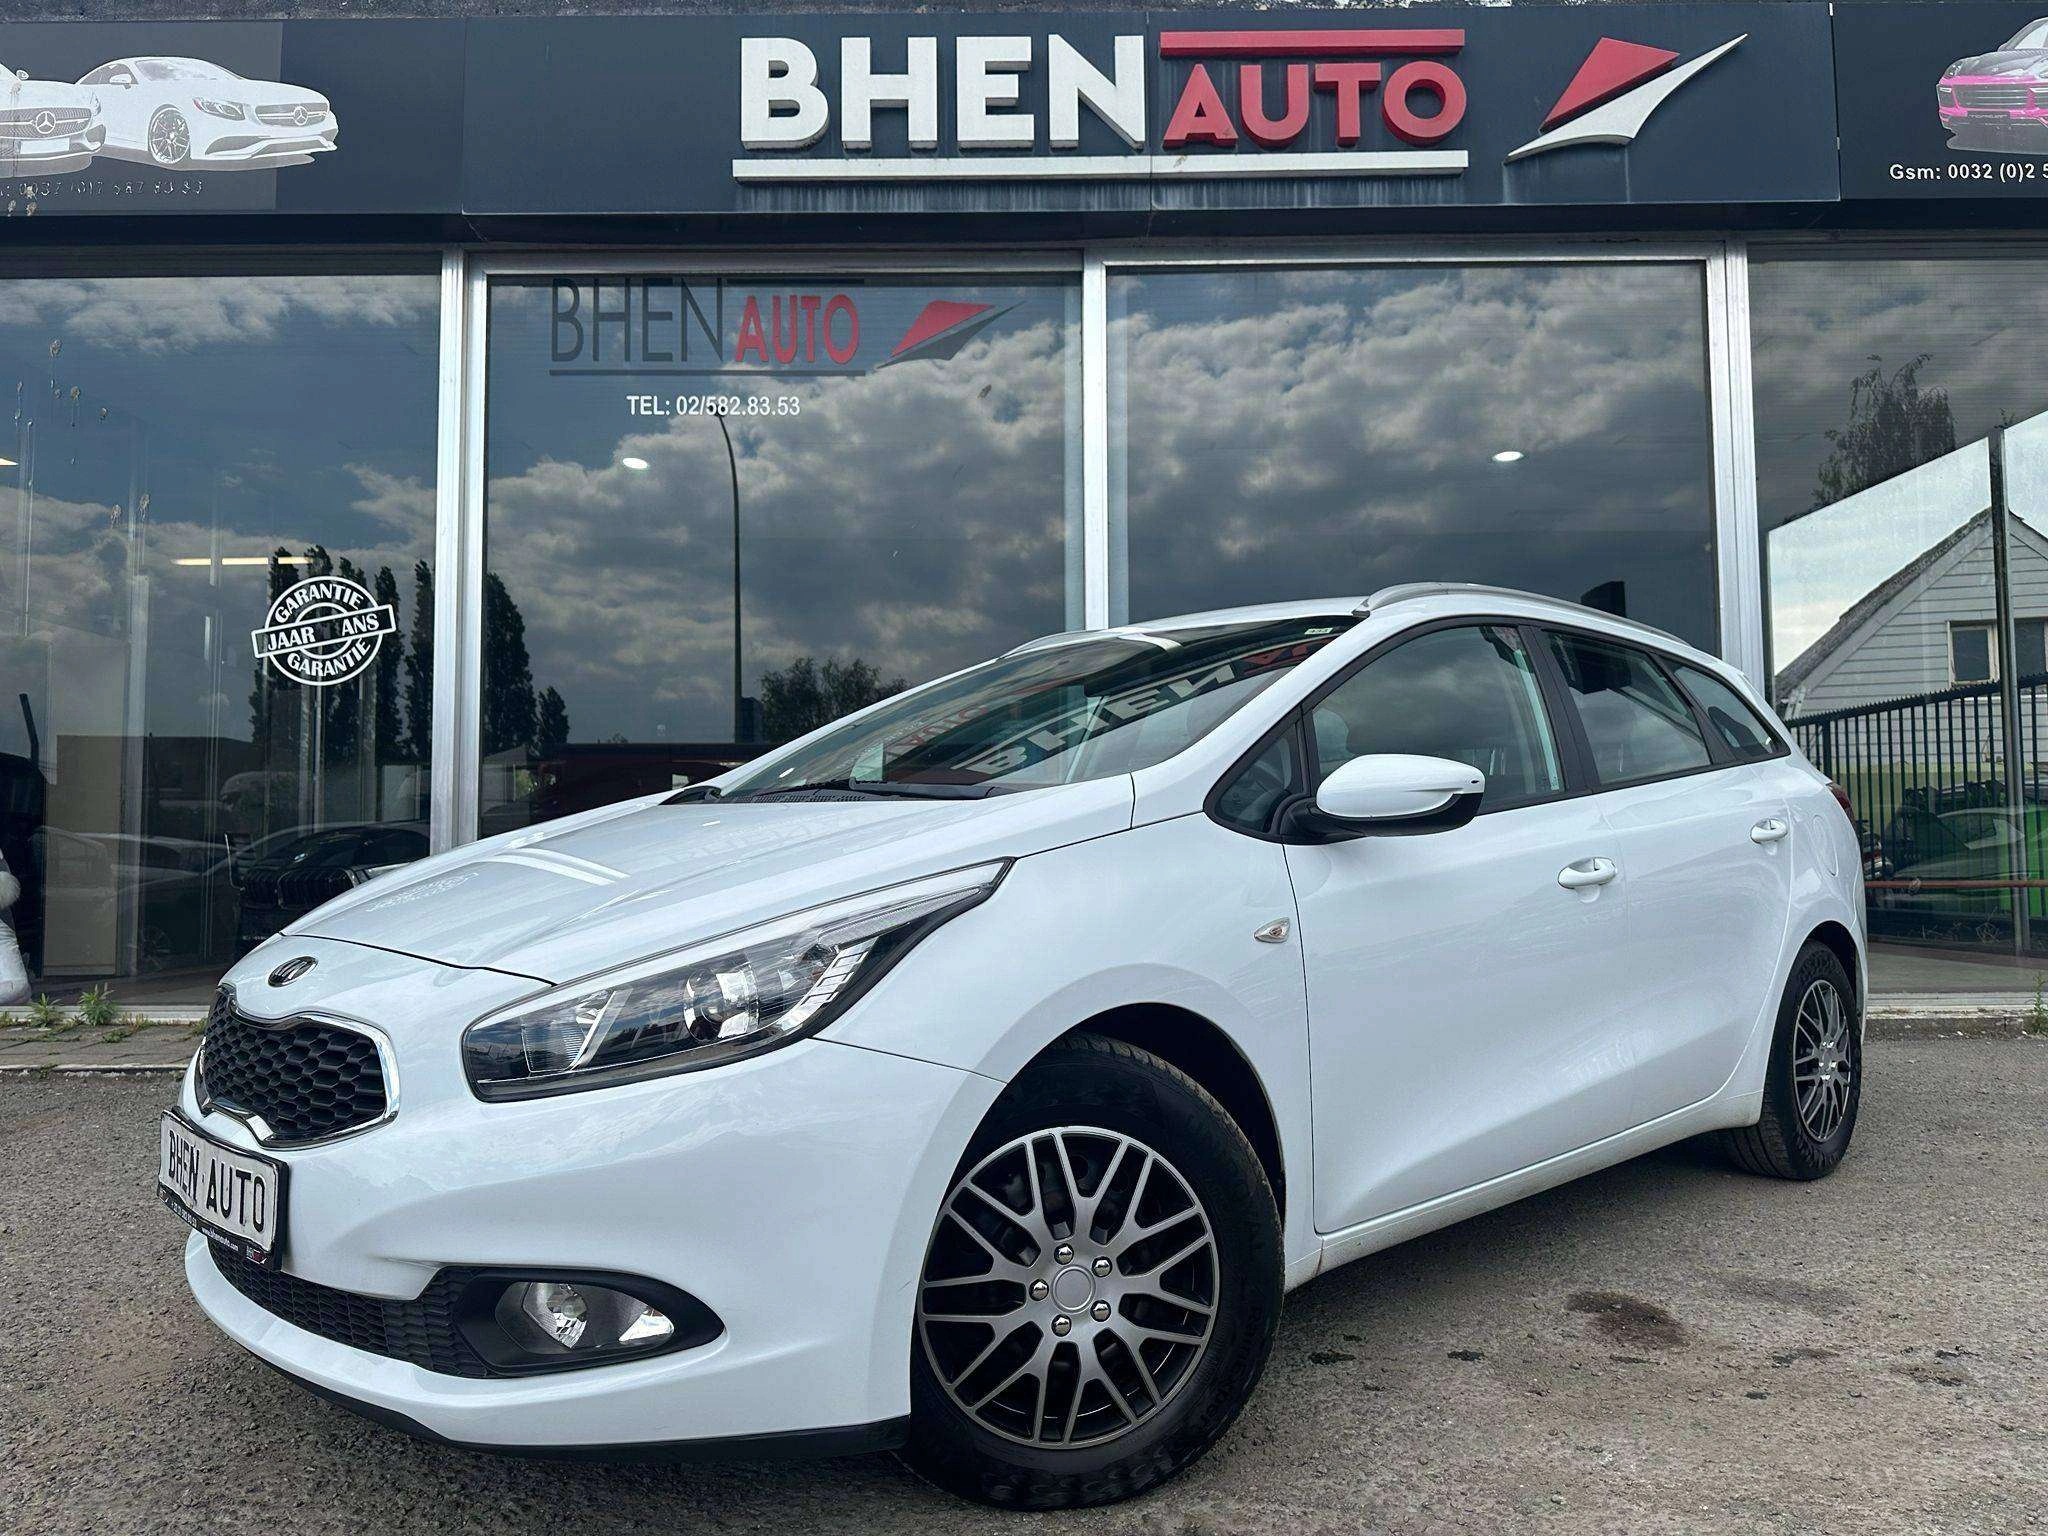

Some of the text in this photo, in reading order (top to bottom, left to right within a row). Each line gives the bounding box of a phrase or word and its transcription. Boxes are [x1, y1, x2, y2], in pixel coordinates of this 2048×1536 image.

[741, 34, 1467, 150] BHEN AUTO
[1889, 163, 1941, 179] Gsm:
[1947, 163, 1993, 179] 0032
[2000, 162, 2035, 183] (0)2
[551, 277, 859, 364] BHEN AUTO
[626, 395, 801, 416] TEL: 02/582.83.53
[274, 583, 364, 623] GARANTIE
[267, 613, 380, 651] JAAR ANS
[287, 638, 371, 677] GARANTIE
[168, 1129, 265, 1233] BHEN AUTO
